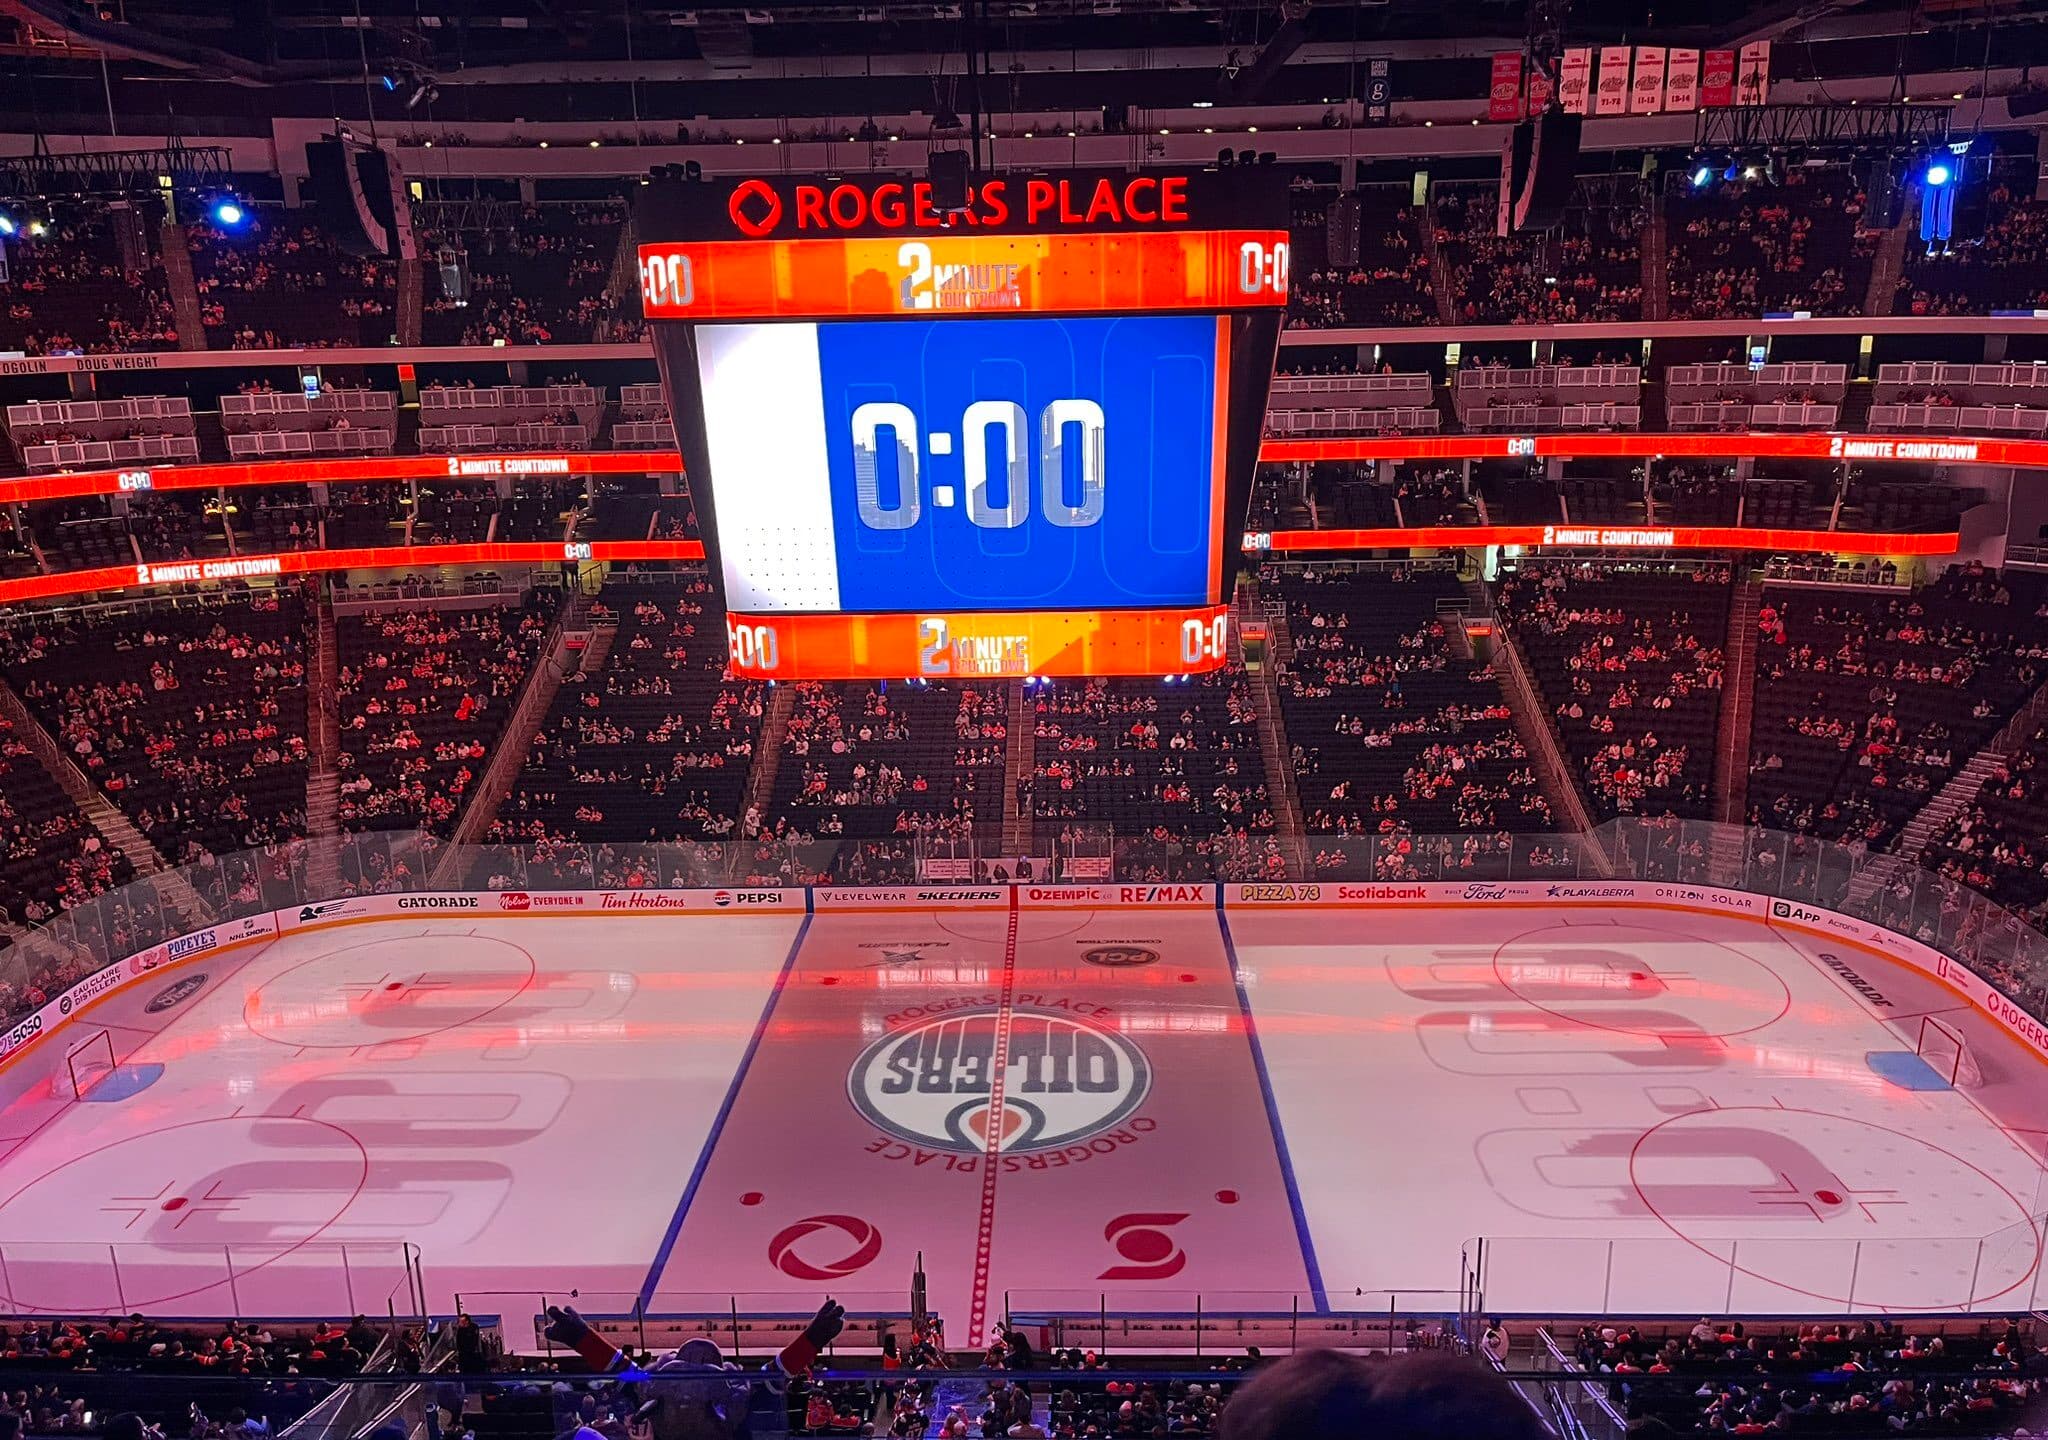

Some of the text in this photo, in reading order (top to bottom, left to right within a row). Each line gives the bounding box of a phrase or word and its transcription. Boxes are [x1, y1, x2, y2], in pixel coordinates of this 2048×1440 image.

[1026, 177, 1189, 224] PLACE
[898, 242, 1018, 309] 2 MINUTE
[77, 358, 109, 370] DOUG
[113, 356, 159, 369] WEIGHT
[1508, 439, 1535, 455] 0:00
[1830, 438, 1978, 460] 2 MINUTE COUNTDOWN
[447, 457, 568, 476] 2 MINUTE COUNTDOWN
[851, 399, 1106, 530] 0:00
[118, 471, 152, 490] 0:00
[1244, 533, 1271, 549] 0:00
[1543, 526, 1674, 545] 2 MINUTE COUNTDOWN
[564, 543, 591, 559] 0:00
[137, 559, 281, 584] 2 MINUTE COUNTDOWN
[919, 617, 1029, 674] 2 MINUTE
[533, 896, 584, 906] EVERYONE IN
[600, 891, 685, 909] Tim Hortons
[737, 892, 782, 904] PEPSI
[834, 893, 906, 901] LEVELWEAR
[917, 891, 1002, 901] SKECHERS
[1120, 886, 1204, 903] RE/MAX
[1241, 885, 1321, 901] PIZZA 73
[1338, 886, 1426, 899] Scotiabank
[1464, 884, 1506, 900] Ford
[1562, 888, 1635, 898] PLAYALBERTA
[1655, 888, 1752, 909] ORIZON SOLAR
[398, 896, 478, 909] GATORADE
[167, 930, 216, 955] POPEYE'S
[73, 966, 121, 998] EAU CLAIRE
[74, 973, 122, 1006] DISTILLERY
[1819, 953, 1894, 1008] GATORADE
[883, 993, 1114, 1026] ROGERS PLACE
[13, 1015, 42, 1045] 5050
[2001, 1003, 2048, 1050] ROGERS
[880, 1016, 1120, 1094] OILERS
[864, 1128, 1139, 1174] ROGERS PLACE
